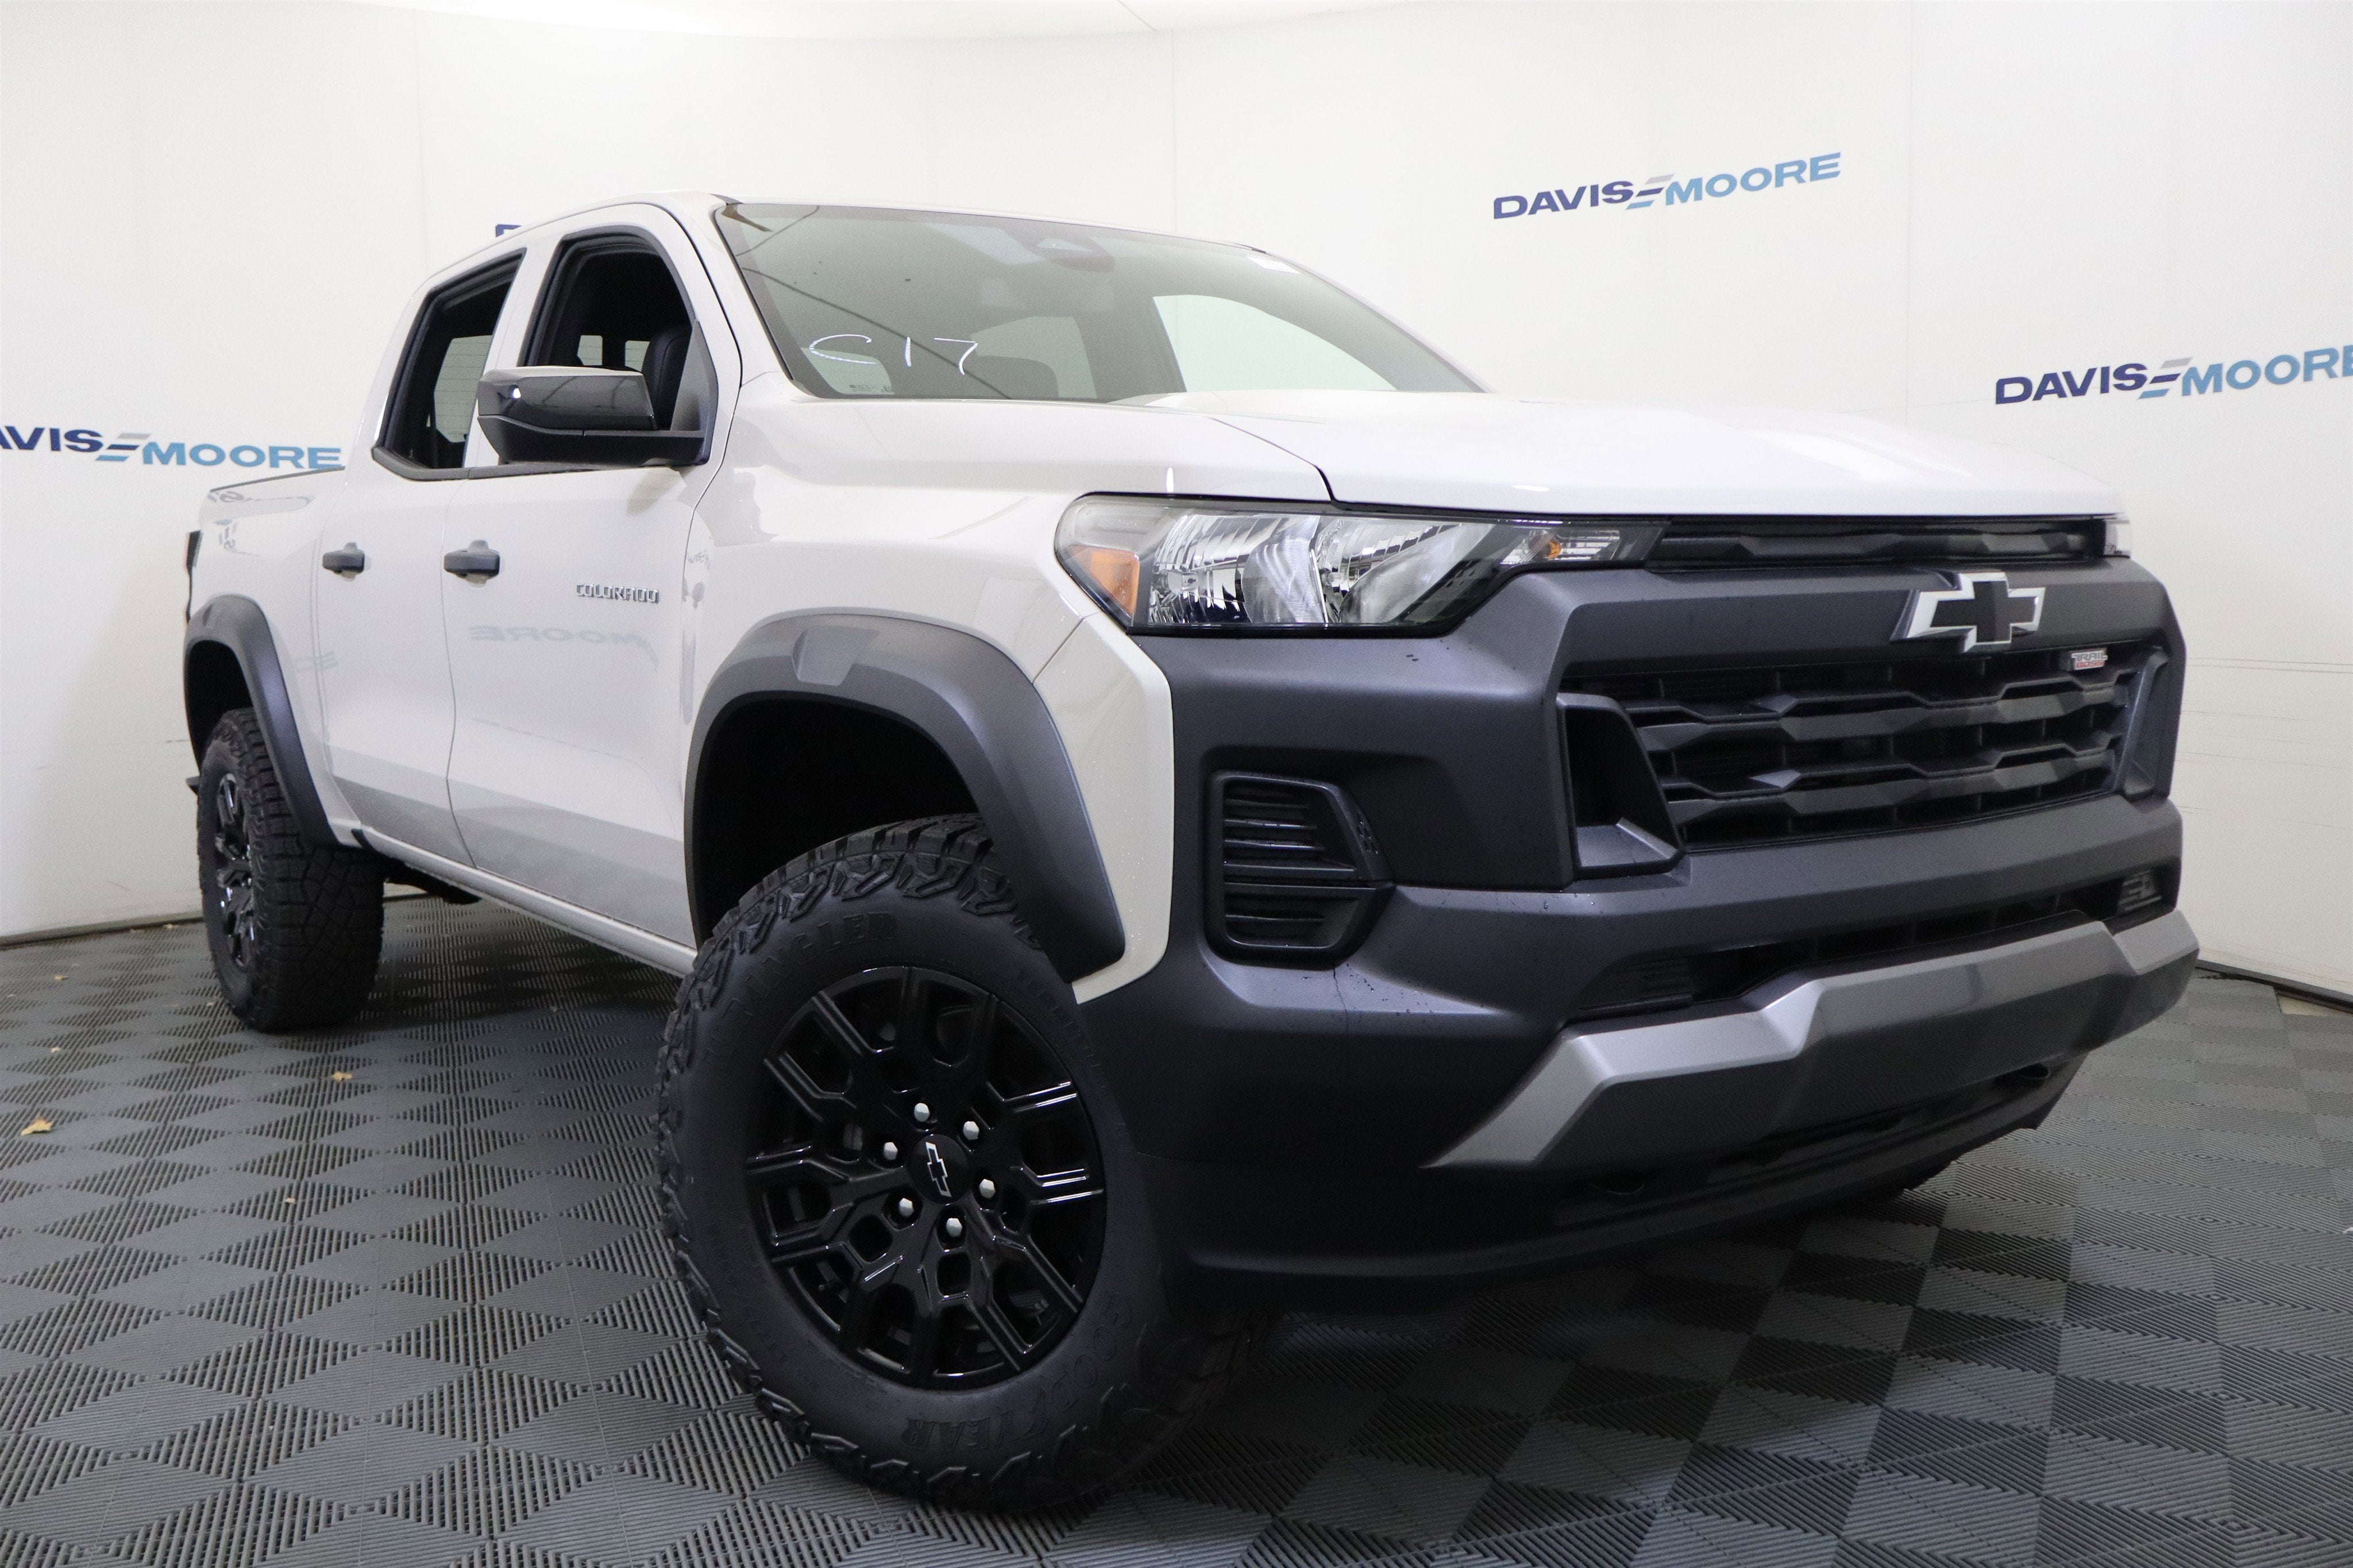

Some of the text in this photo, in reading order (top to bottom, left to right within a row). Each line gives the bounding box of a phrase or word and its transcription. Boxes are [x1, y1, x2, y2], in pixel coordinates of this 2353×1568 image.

[1494, 152, 1841, 219] DAVIS MOORE
[1996, 363, 2148, 404] DAVIS
[142, 442, 341, 469] MOORE
[576, 582, 659, 604] COLORADO
[2071, 650, 2108, 662] TRAIL
[900, 1289, 1134, 1452] GOODYEAR
